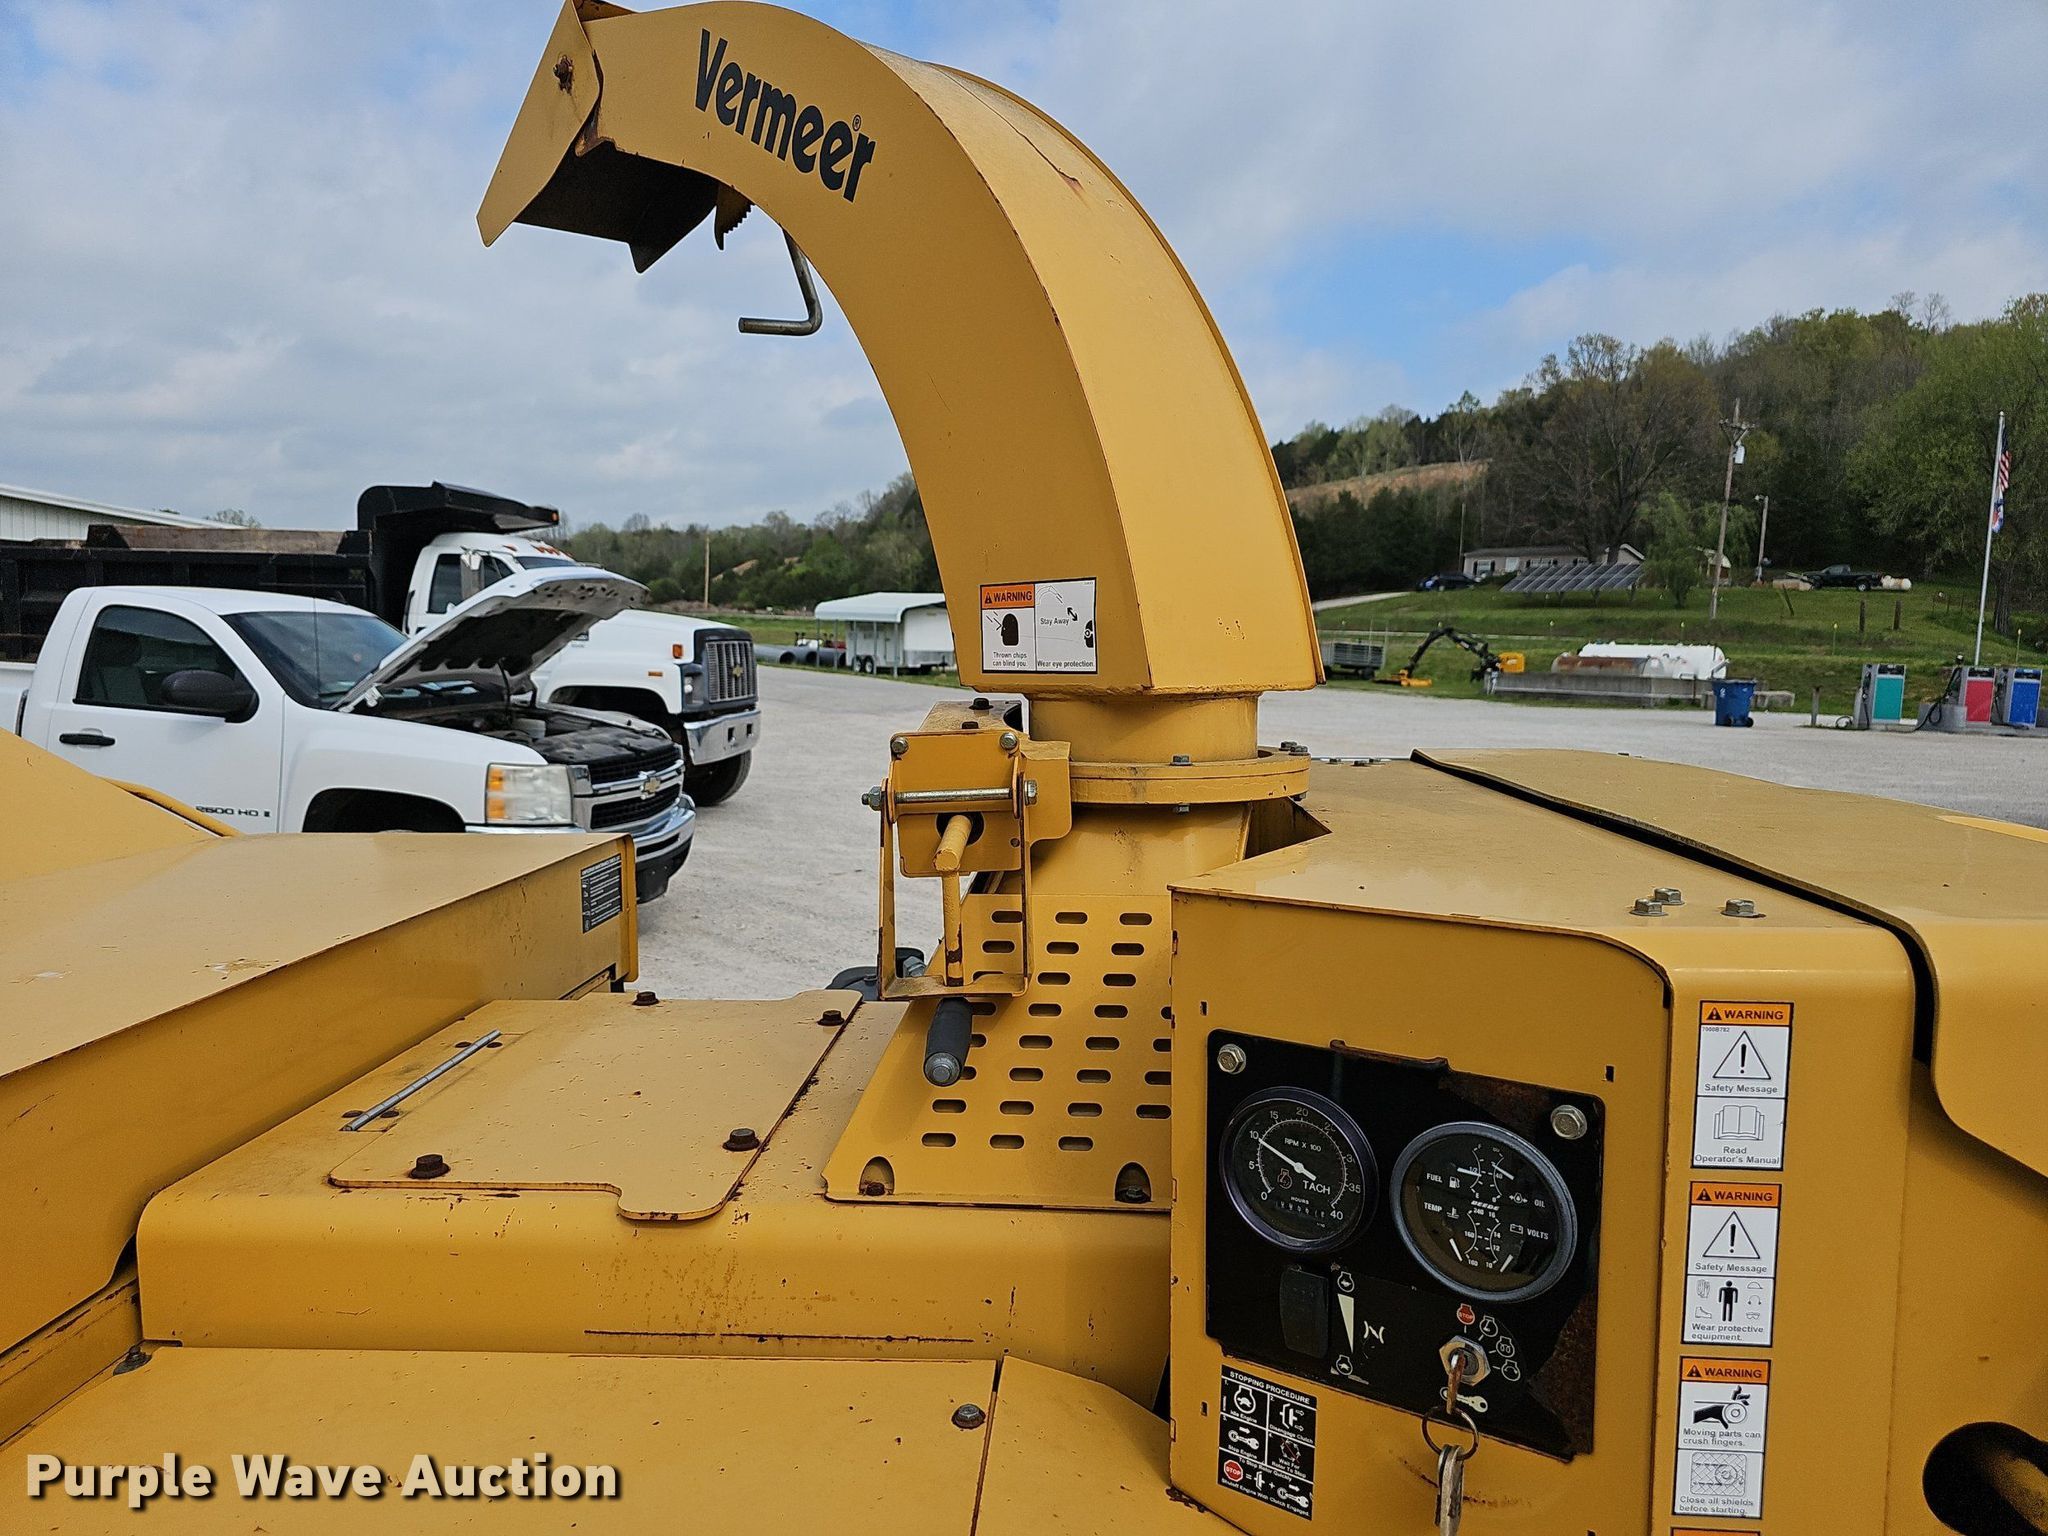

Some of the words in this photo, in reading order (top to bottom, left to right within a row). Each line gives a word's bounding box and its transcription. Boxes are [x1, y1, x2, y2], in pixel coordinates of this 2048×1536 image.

[695, 27, 877, 203] Vermeer
[994, 591, 1032, 602] WARNING
[1040, 617, 1052, 626] Stay
[1054, 617, 1069, 626] Away
[993, 651, 1011, 659] Thrown
[1013, 651, 1027, 660] chips
[1038, 660, 1051, 668] Wear
[1053, 661, 1062, 669] eye
[238, 809, 259, 817] HD
[1724, 1009, 1783, 1020] WARNING
[1705, 1083, 1734, 1093] Safety
[1737, 1084, 1778, 1094] Message
[1269, 1110, 1279, 1119] 15
[1296, 1106, 1309, 1117] 20
[1250, 1130, 1259, 1140] 10
[1284, 1137, 1300, 1147] RPM
[1301, 1141, 1307, 1149] X
[1310, 1143, 1322, 1153] 100
[1723, 1146, 1747, 1154] Read
[1694, 1154, 1743, 1164] Operator's
[1746, 1156, 1780, 1164] Manual
[1248, 1160, 1255, 1170] 5
[1426, 1173, 1443, 1184] FUEL
[1303, 1179, 1331, 1196] TACH
[1348, 1183, 1361, 1194] 35
[1260, 1191, 1268, 1201] 0
[1714, 1191, 1773, 1202] WARNING
[1423, 1202, 1443, 1213] TEMP
[1534, 1199, 1546, 1208] OIL
[1329, 1210, 1344, 1220] 40
[1526, 1228, 1549, 1240] VOLTS
[1695, 1262, 1724, 1272] Safety
[1726, 1263, 1768, 1274] Message
[1692, 1323, 1715, 1331] Wear
[1717, 1325, 1764, 1334] protective
[1691, 1333, 1742, 1342] equipment.
[1704, 1367, 1763, 1379] WARNING
[1230, 1371, 1265, 1389] STOPPING
[1265, 1383, 1310, 1405] PROCEDURE
[1240, 1413, 1258, 1424] Engine
[1683, 1428, 1716, 1438] Moving
[1683, 1437, 1709, 1445] crush
[1711, 1438, 1745, 1447] fingers.
[1240, 1449, 1257, 1460] Engine
[1226, 1466, 1241, 1476] STOP
[1239, 1485, 1257, 1496] Engine
[1721, 1497, 1754, 1506] shields
[1679, 1505, 1708, 1513] before
[1710, 1507, 1747, 1515] starting.
